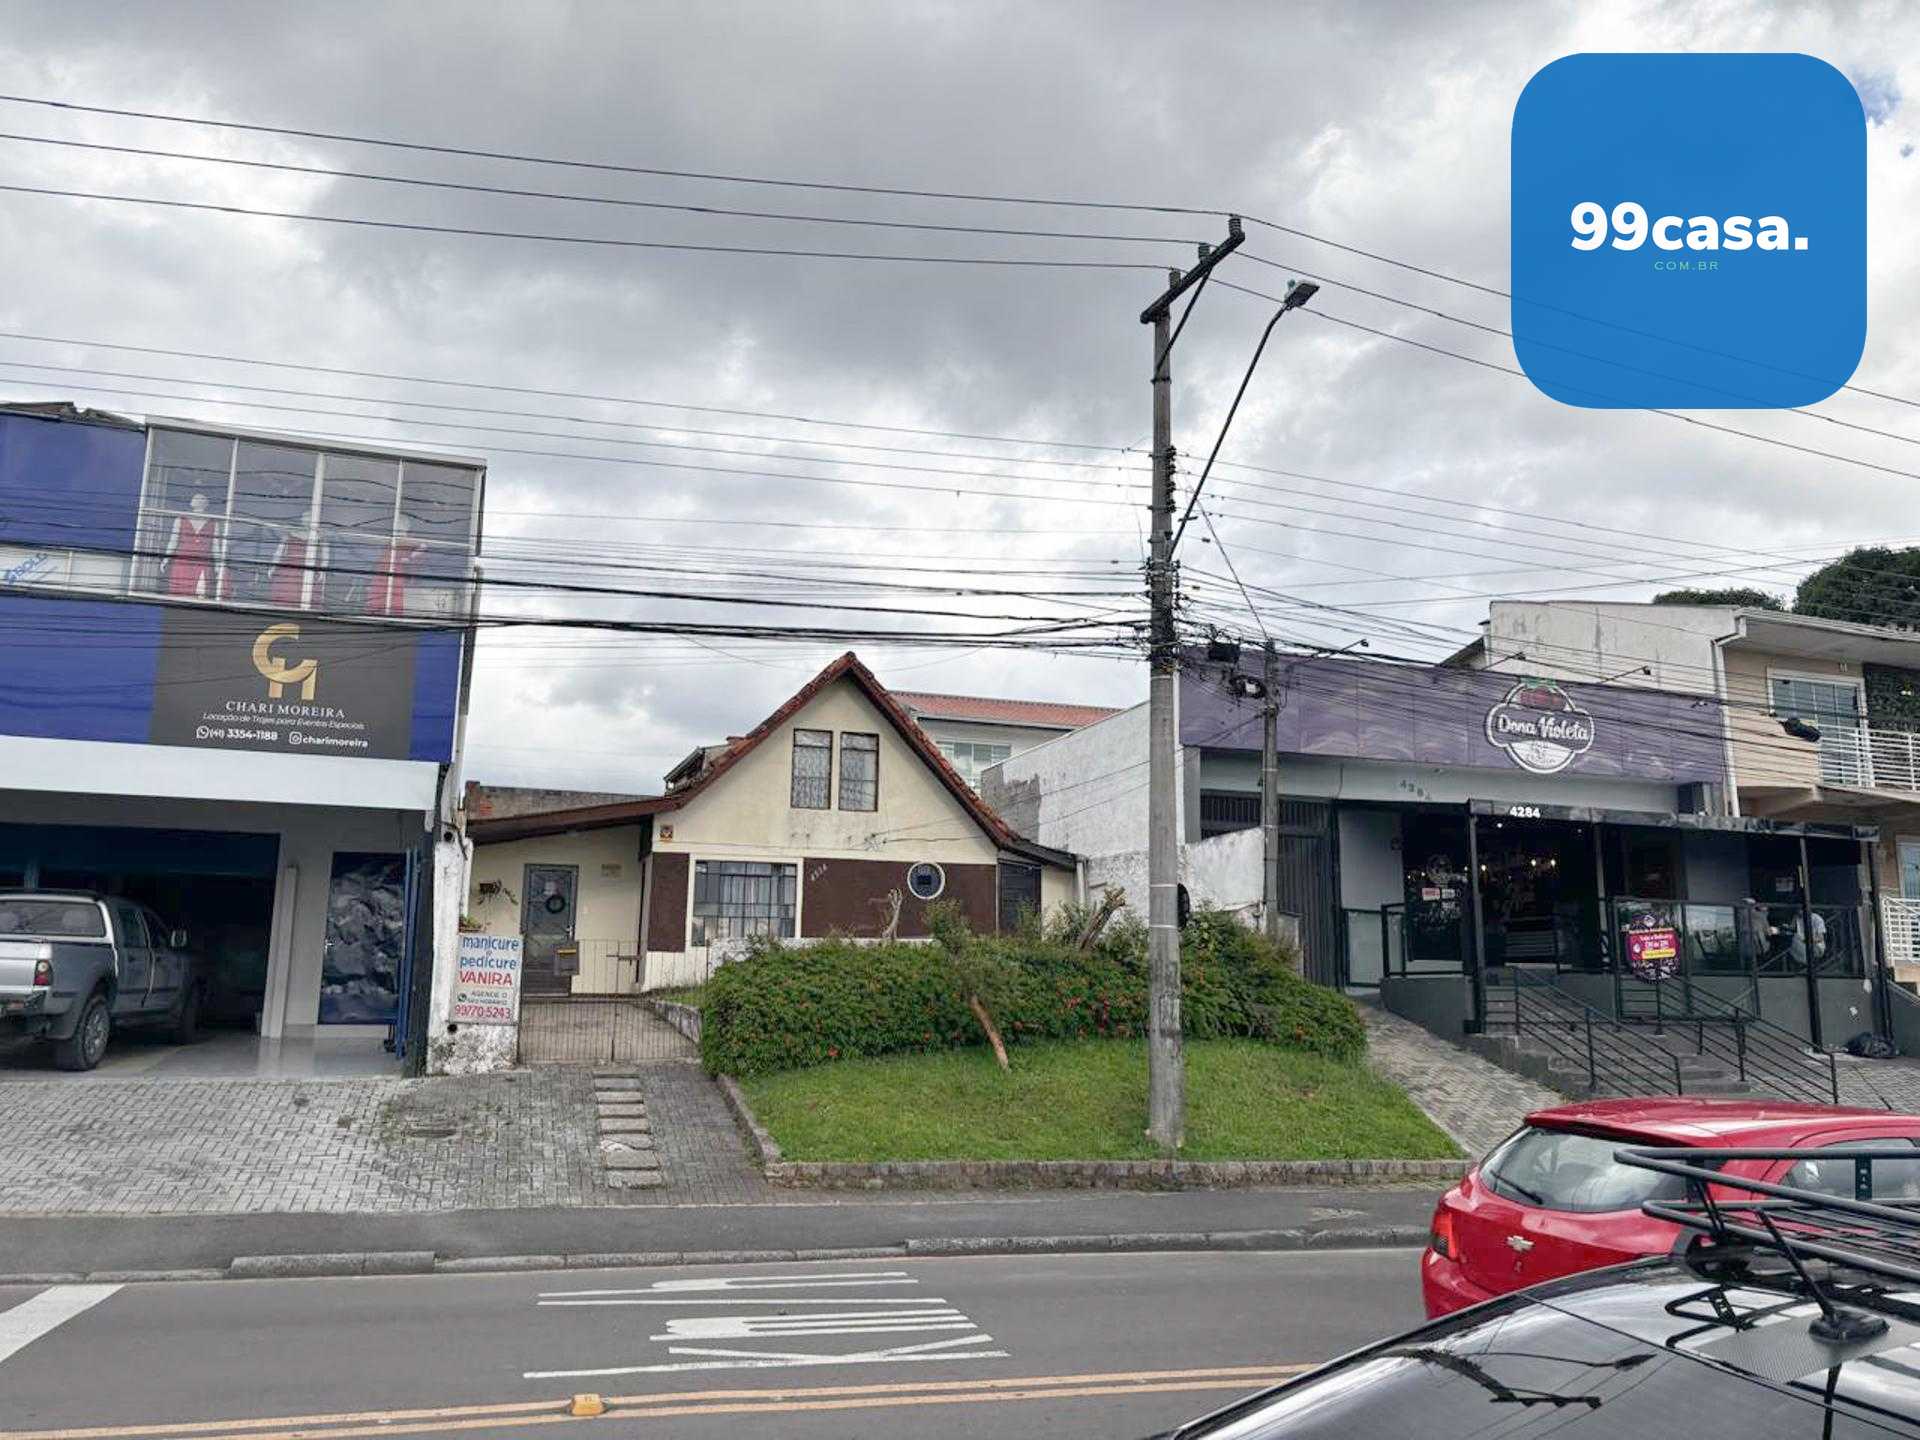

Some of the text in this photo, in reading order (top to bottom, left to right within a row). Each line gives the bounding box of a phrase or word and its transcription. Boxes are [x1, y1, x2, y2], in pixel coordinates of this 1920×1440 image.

[226, 701, 345, 719] CHARI MOREIRA
[1497, 714, 1590, 740] Dona Violeta
[1509, 806, 1541, 818] 4284
[463, 936, 519, 950] manicure
[460, 956, 516, 969] pedicure
[459, 971, 513, 985] VANIRA
